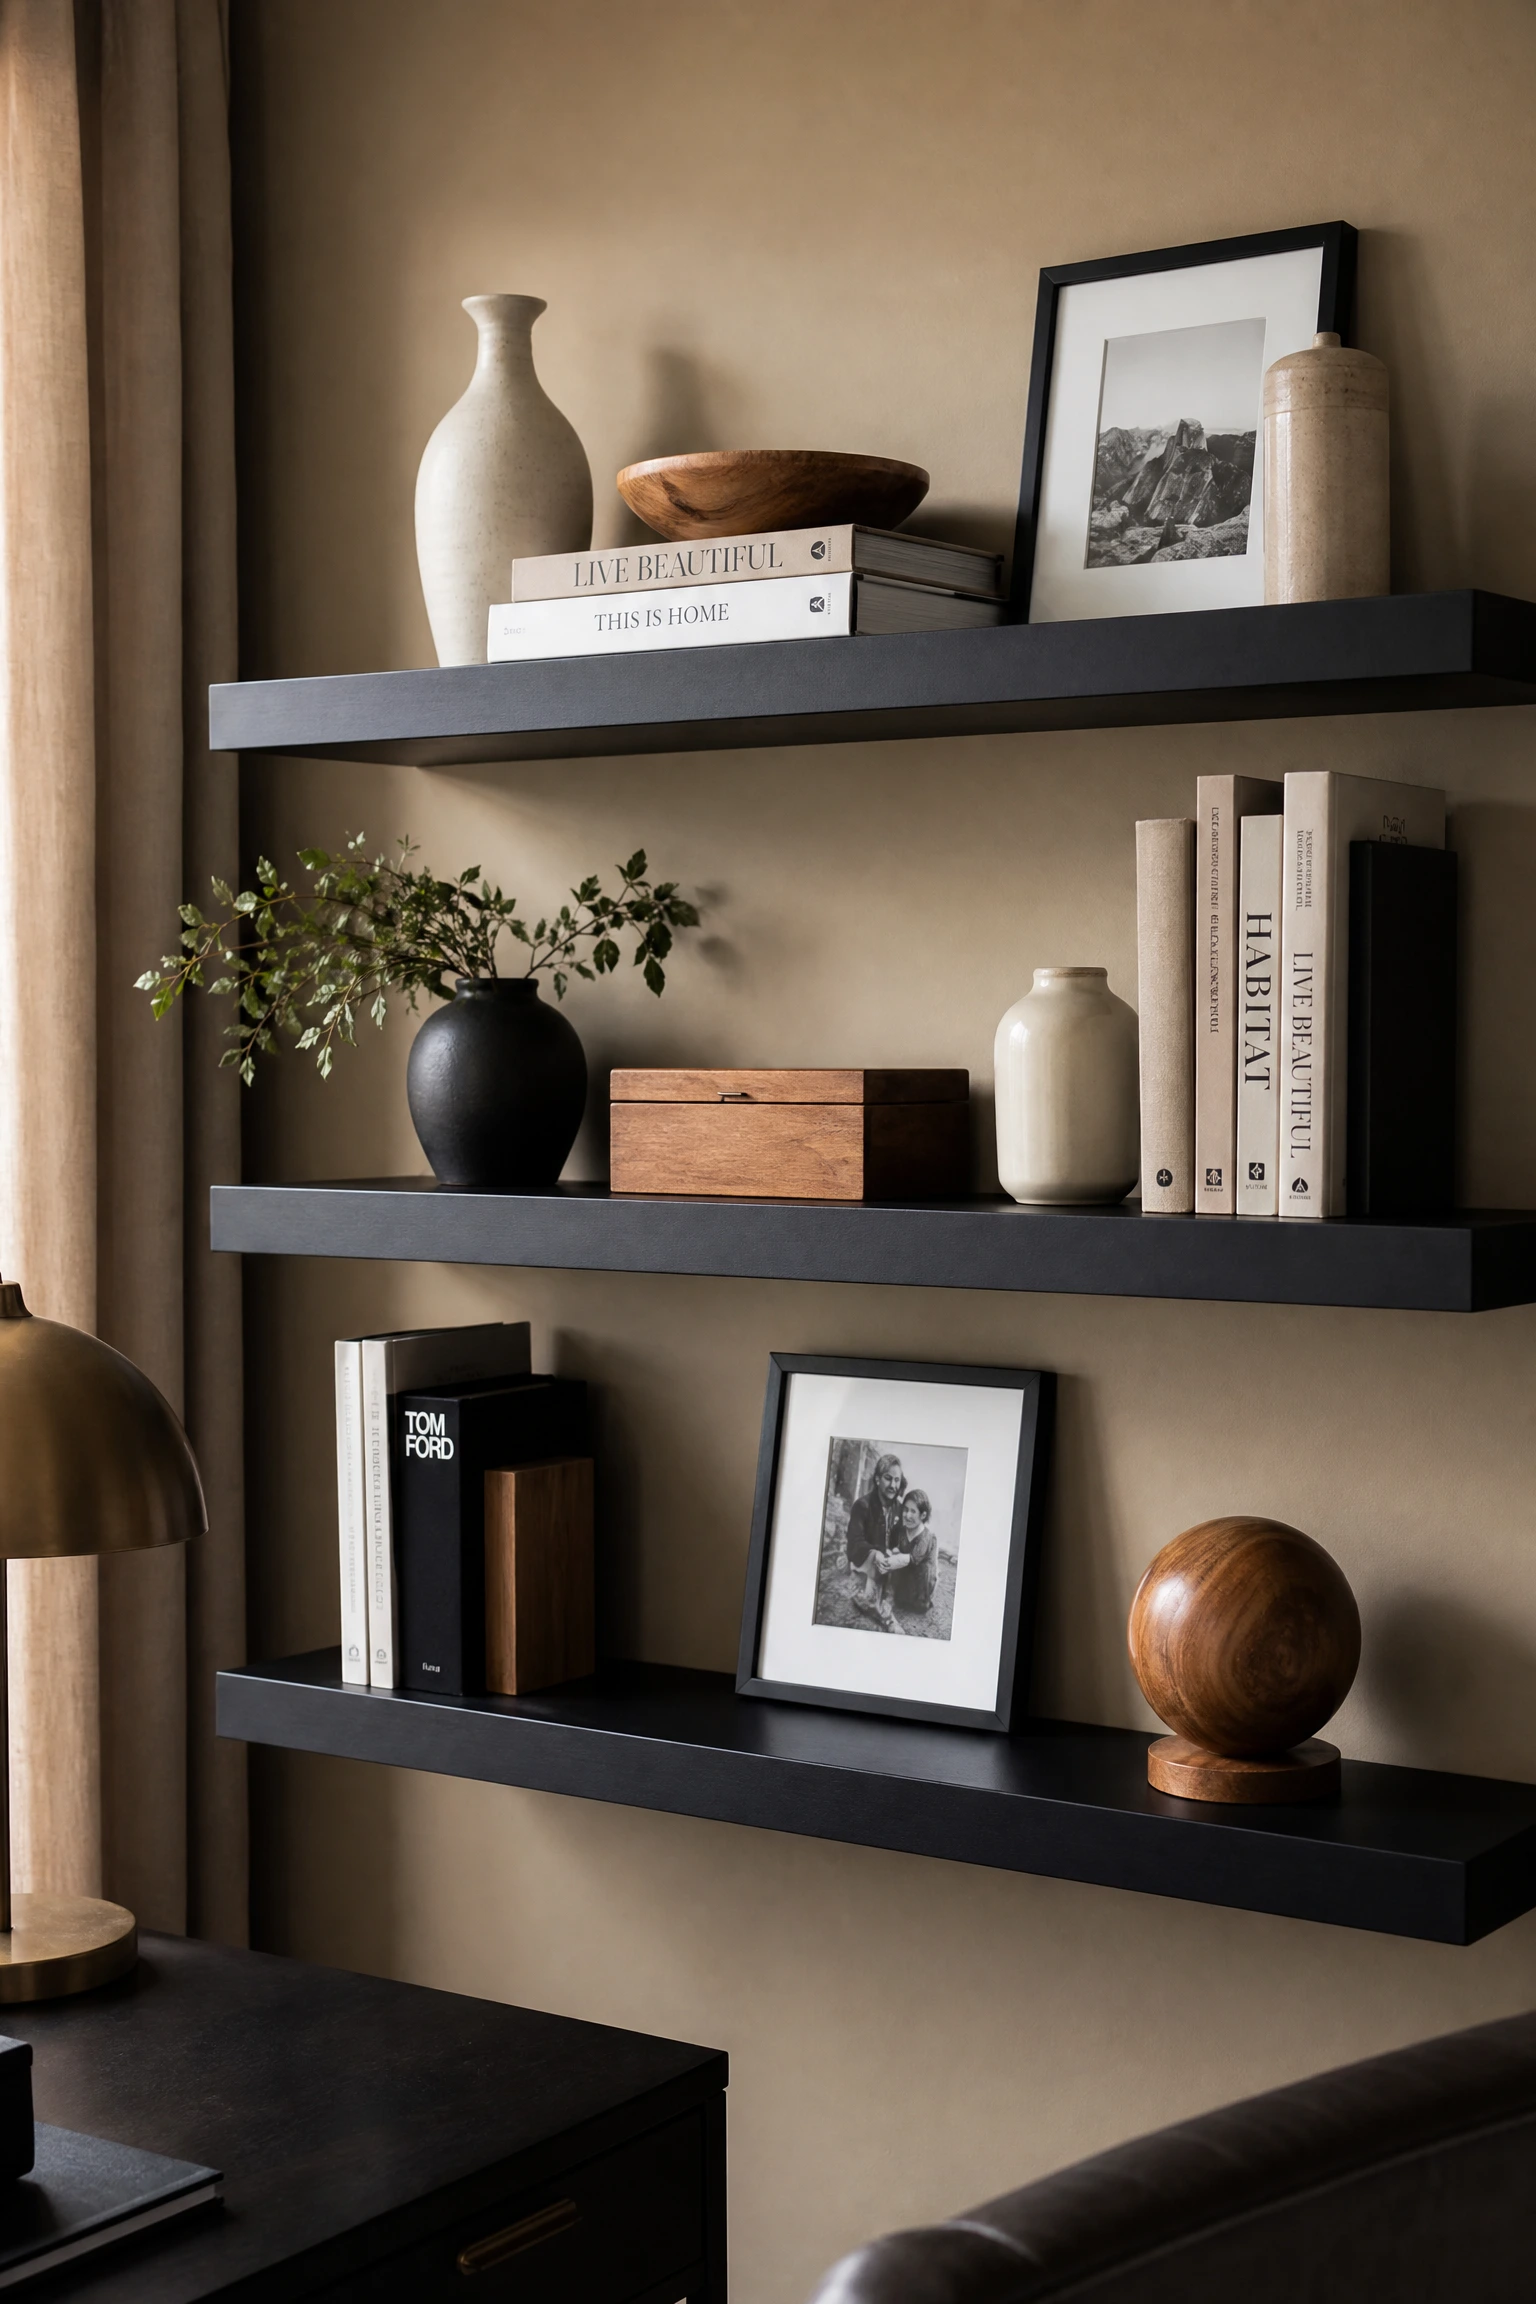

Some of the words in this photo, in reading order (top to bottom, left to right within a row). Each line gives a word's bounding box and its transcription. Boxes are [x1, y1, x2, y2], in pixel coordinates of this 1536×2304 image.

[574, 557, 629, 588] LIVE
[637, 543, 783, 582] BEAUTIFUL
[594, 611, 640, 632] THIS
[645, 609, 662, 628] IS
[668, 603, 730, 626] HOME
[1244, 912, 1272, 1091] HABITAT
[1291, 952, 1314, 1008] LIVE
[1290, 1016, 1313, 1159] BEAUTIFUL
[405, 1410, 446, 1437] TOM
[405, 1434, 454, 1460] FORD
